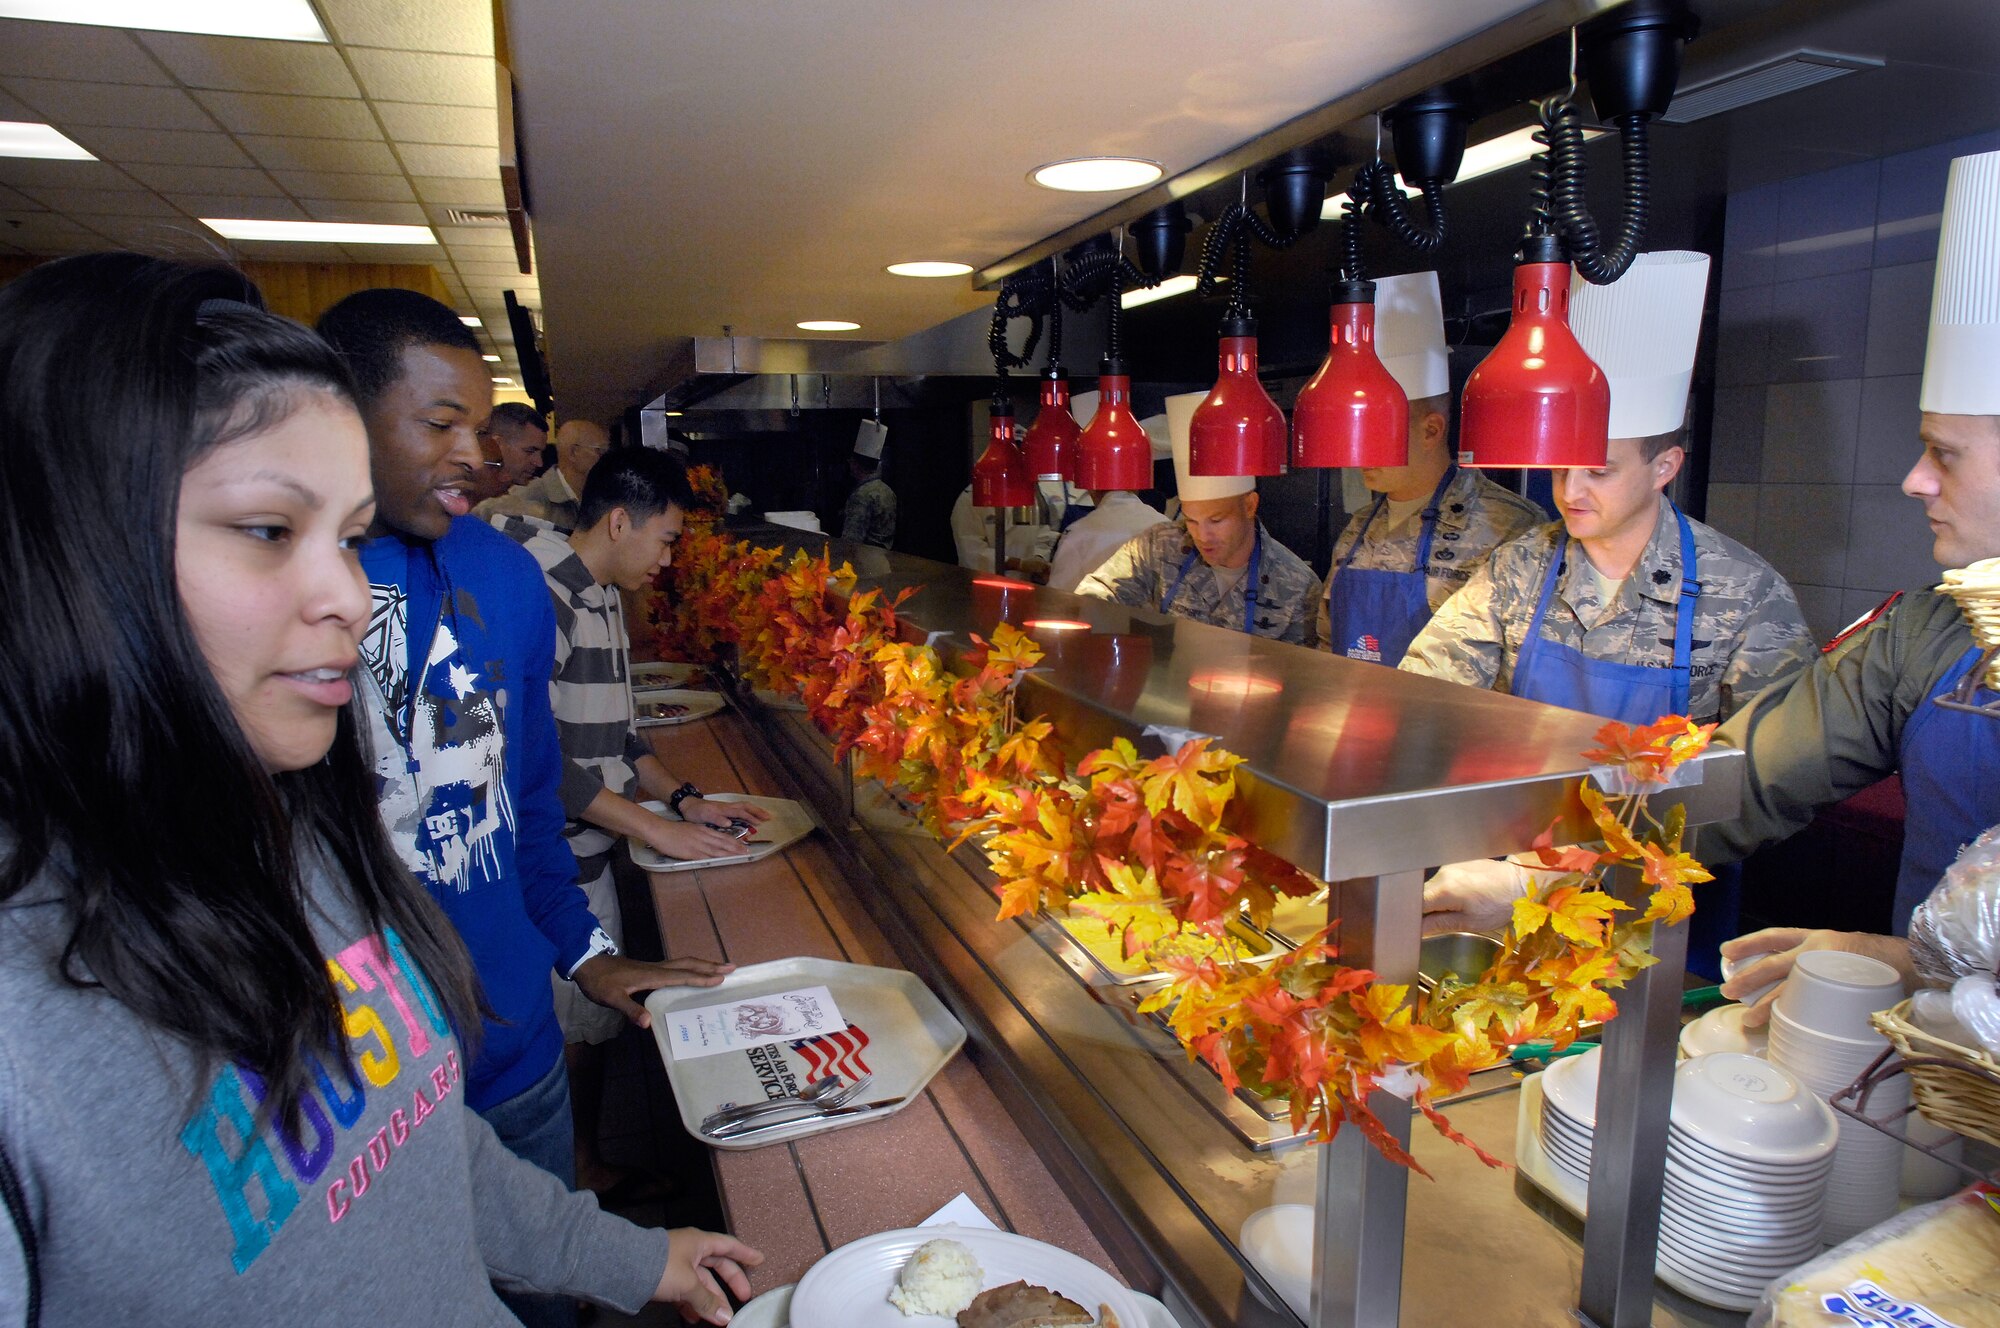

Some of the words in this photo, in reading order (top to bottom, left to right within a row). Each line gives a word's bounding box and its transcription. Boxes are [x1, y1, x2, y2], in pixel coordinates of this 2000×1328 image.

[1689, 663, 1718, 677] ORCE
[180, 926, 450, 1275] HOUST
[774, 1060, 788, 1075] AIR
[781, 1073, 800, 1098] FORC
[327, 1050, 460, 1223] COUGARS
